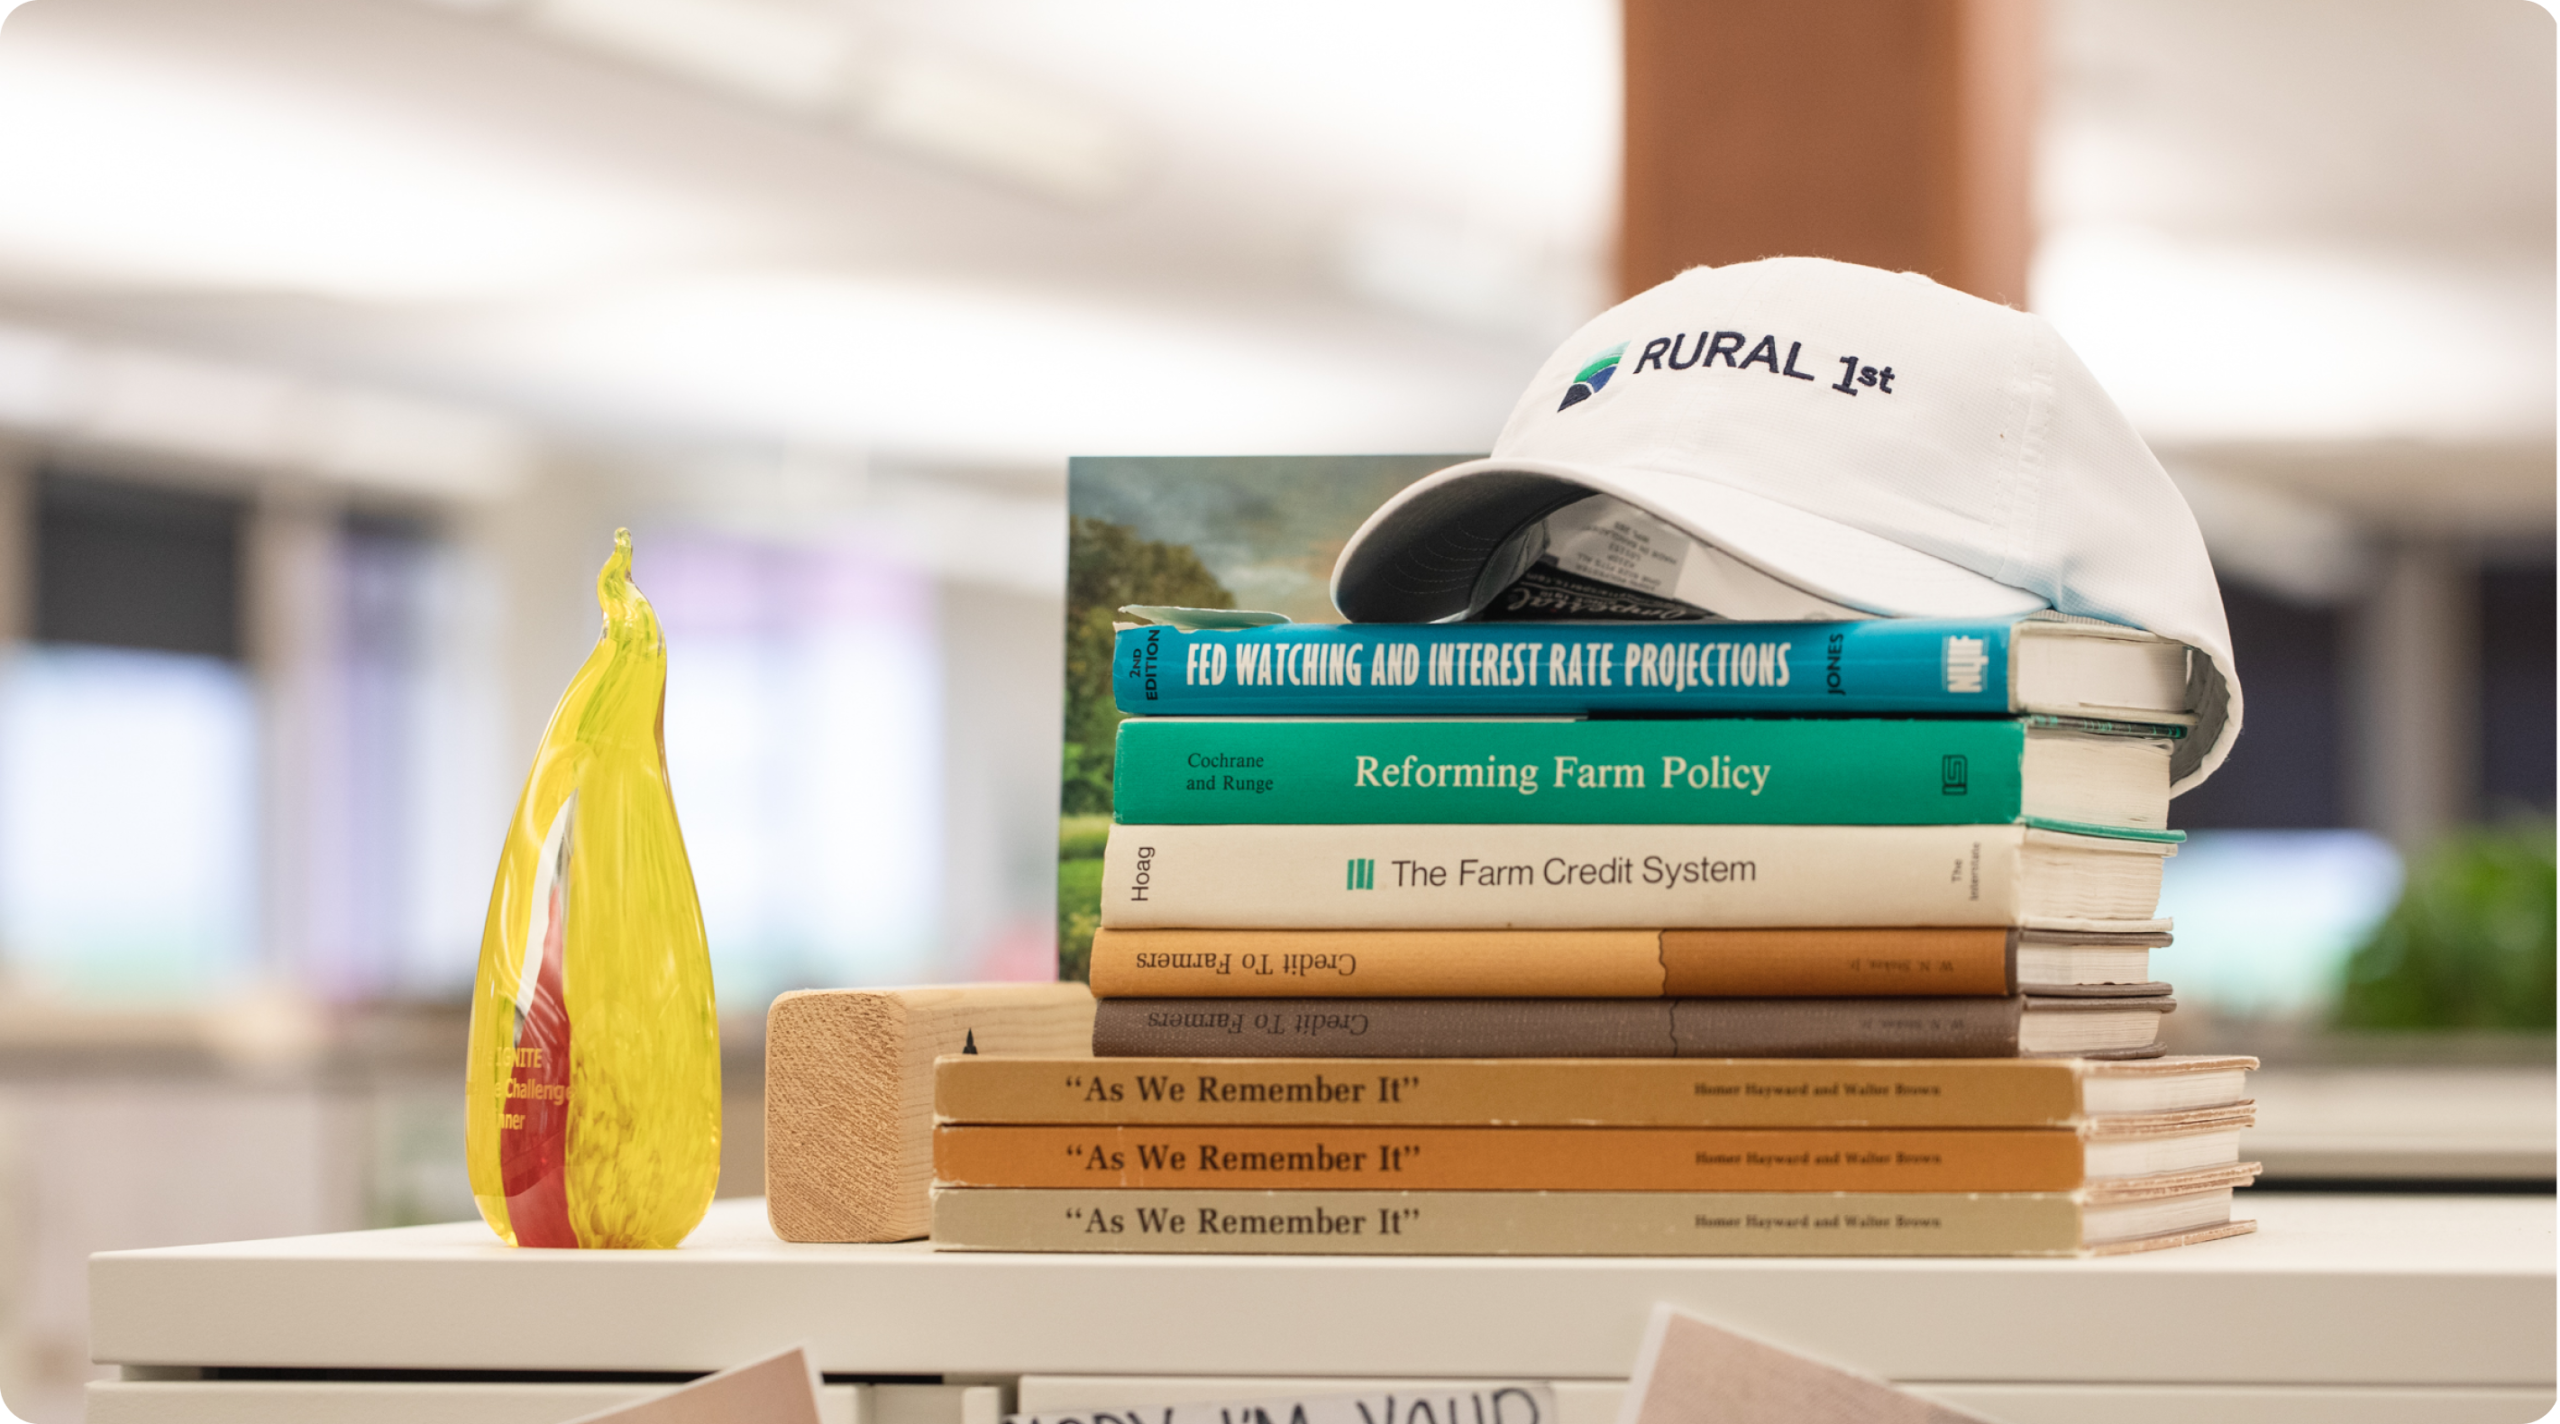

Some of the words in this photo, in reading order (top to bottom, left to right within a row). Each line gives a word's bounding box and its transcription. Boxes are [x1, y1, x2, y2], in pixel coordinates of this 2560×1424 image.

[1632, 331, 1815, 381] RURAL
[1832, 355, 1896, 396] 1st
[1129, 648, 1142, 679] 2ND
[1144, 629, 1160, 701] EDITION
[1186, 642, 1228, 686] FED
[1235, 642, 1364, 687] WATCHING
[1370, 642, 1420, 686] AND
[1428, 642, 1543, 687] INTEREST
[1548, 642, 1614, 687] RATE
[1624, 642, 1792, 692] PROJECTIONS
[1826, 633, 1845, 695] JONES
[1187, 752, 1265, 769] Cochrane
[1186, 775, 1216, 791] and
[1222, 775, 1274, 794] Runge
[1355, 755, 1539, 795] Reforming
[1553, 756, 1645, 788] Farm
[1661, 755, 1771, 796] Policy
[1131, 846, 1155, 902] Hoag
[1391, 860, 1447, 887] The
[1459, 858, 1534, 886] Farm
[1543, 856, 1634, 886] Credit
[1642, 855, 1756, 889] System
[1951, 859, 1962, 884] The
[1136, 952, 1231, 976] Farmers
[1242, 953, 1274, 976] To
[1283, 953, 1357, 977] Credit
[1147, 1012, 1244, 1035] Farmers
[1254, 1013, 1286, 1035] To
[1294, 1014, 1369, 1036] Credit
[495, 1046, 543, 1068] IGNITE
[504, 1077, 576, 1105] Challenge
[1137, 1076, 1185, 1102] We
[1198, 1075, 1366, 1103] Remember
[1694, 1083, 1741, 1096] Homer
[1745, 1083, 1810, 1099] Hayward
[1813, 1083, 1839, 1096] and
[1843, 1083, 1890, 1096] Walter
[1895, 1083, 1942, 1096] Brown
[1138, 1144, 1186, 1170] We
[1199, 1143, 1367, 1171] Remember
[1695, 1151, 1742, 1164] Homer
[1746, 1151, 1811, 1167] Hayward
[1814, 1151, 1840, 1164] and
[1844, 1151, 1891, 1164] Walter
[1896, 1151, 1943, 1164] Brown
[1138, 1207, 1186, 1233] We
[1199, 1206, 1367, 1234] Remember
[1695, 1214, 1742, 1227] Homer
[1746, 1214, 1811, 1230] Hayward
[1814, 1214, 1840, 1227] and
[1844, 1214, 1891, 1227] Walter
[1896, 1214, 1943, 1227] Brown
